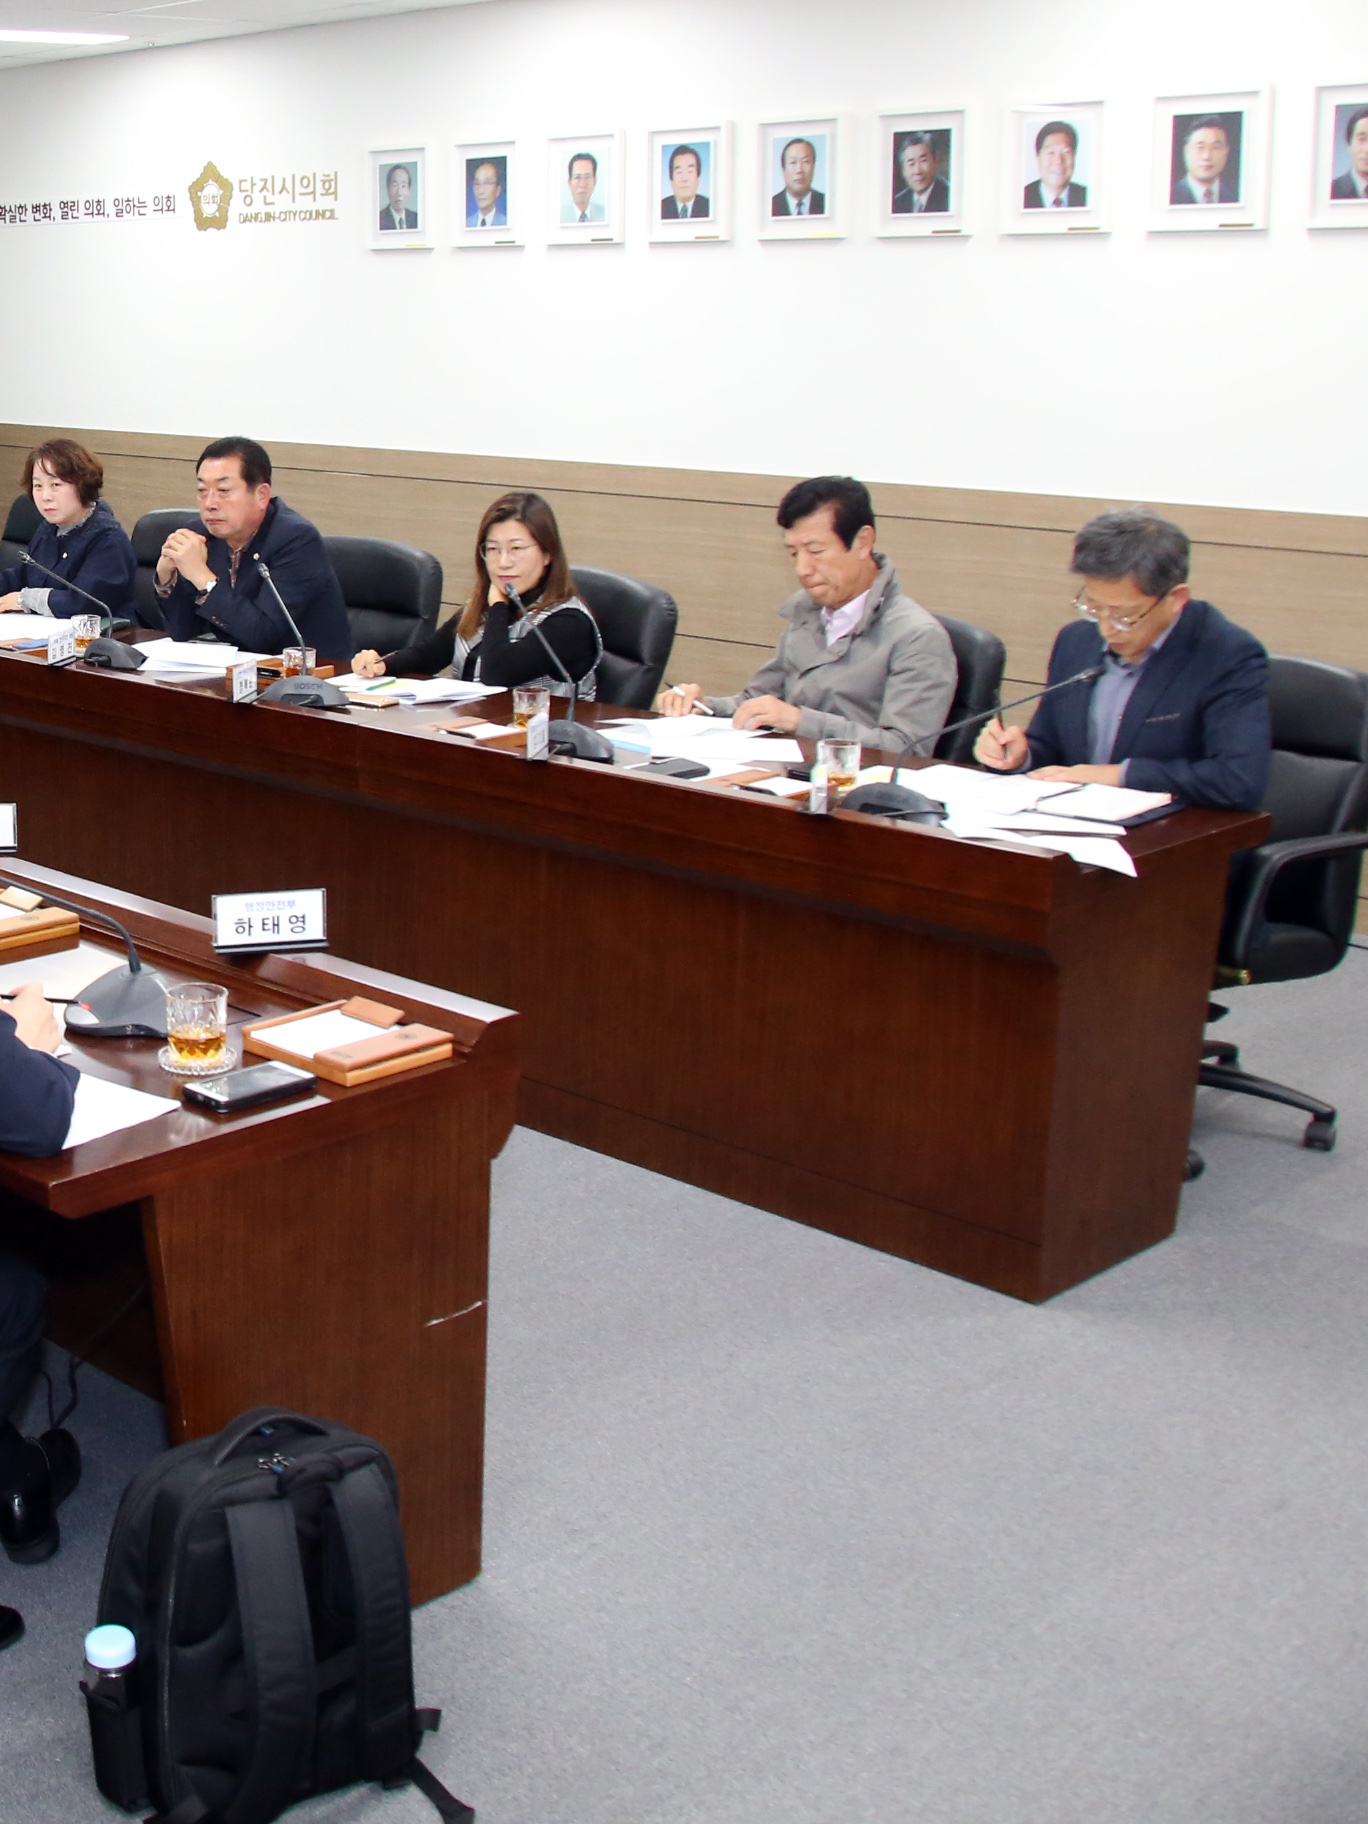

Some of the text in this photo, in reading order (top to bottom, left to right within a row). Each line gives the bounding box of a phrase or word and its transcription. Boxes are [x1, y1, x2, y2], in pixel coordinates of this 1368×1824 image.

[239, 171, 338, 207] 당진시의회
[31, 202, 56, 222] 변화,
[59, 200, 80, 220] 열린
[84, 198, 110, 218] 의회,
[113, 197, 148, 218] 일하는
[153, 194, 176, 215] 의회
[299, 208, 339, 222] COUNCIL
[293, 682, 323, 690] BOSCH
[234, 913, 306, 937] 하태영
